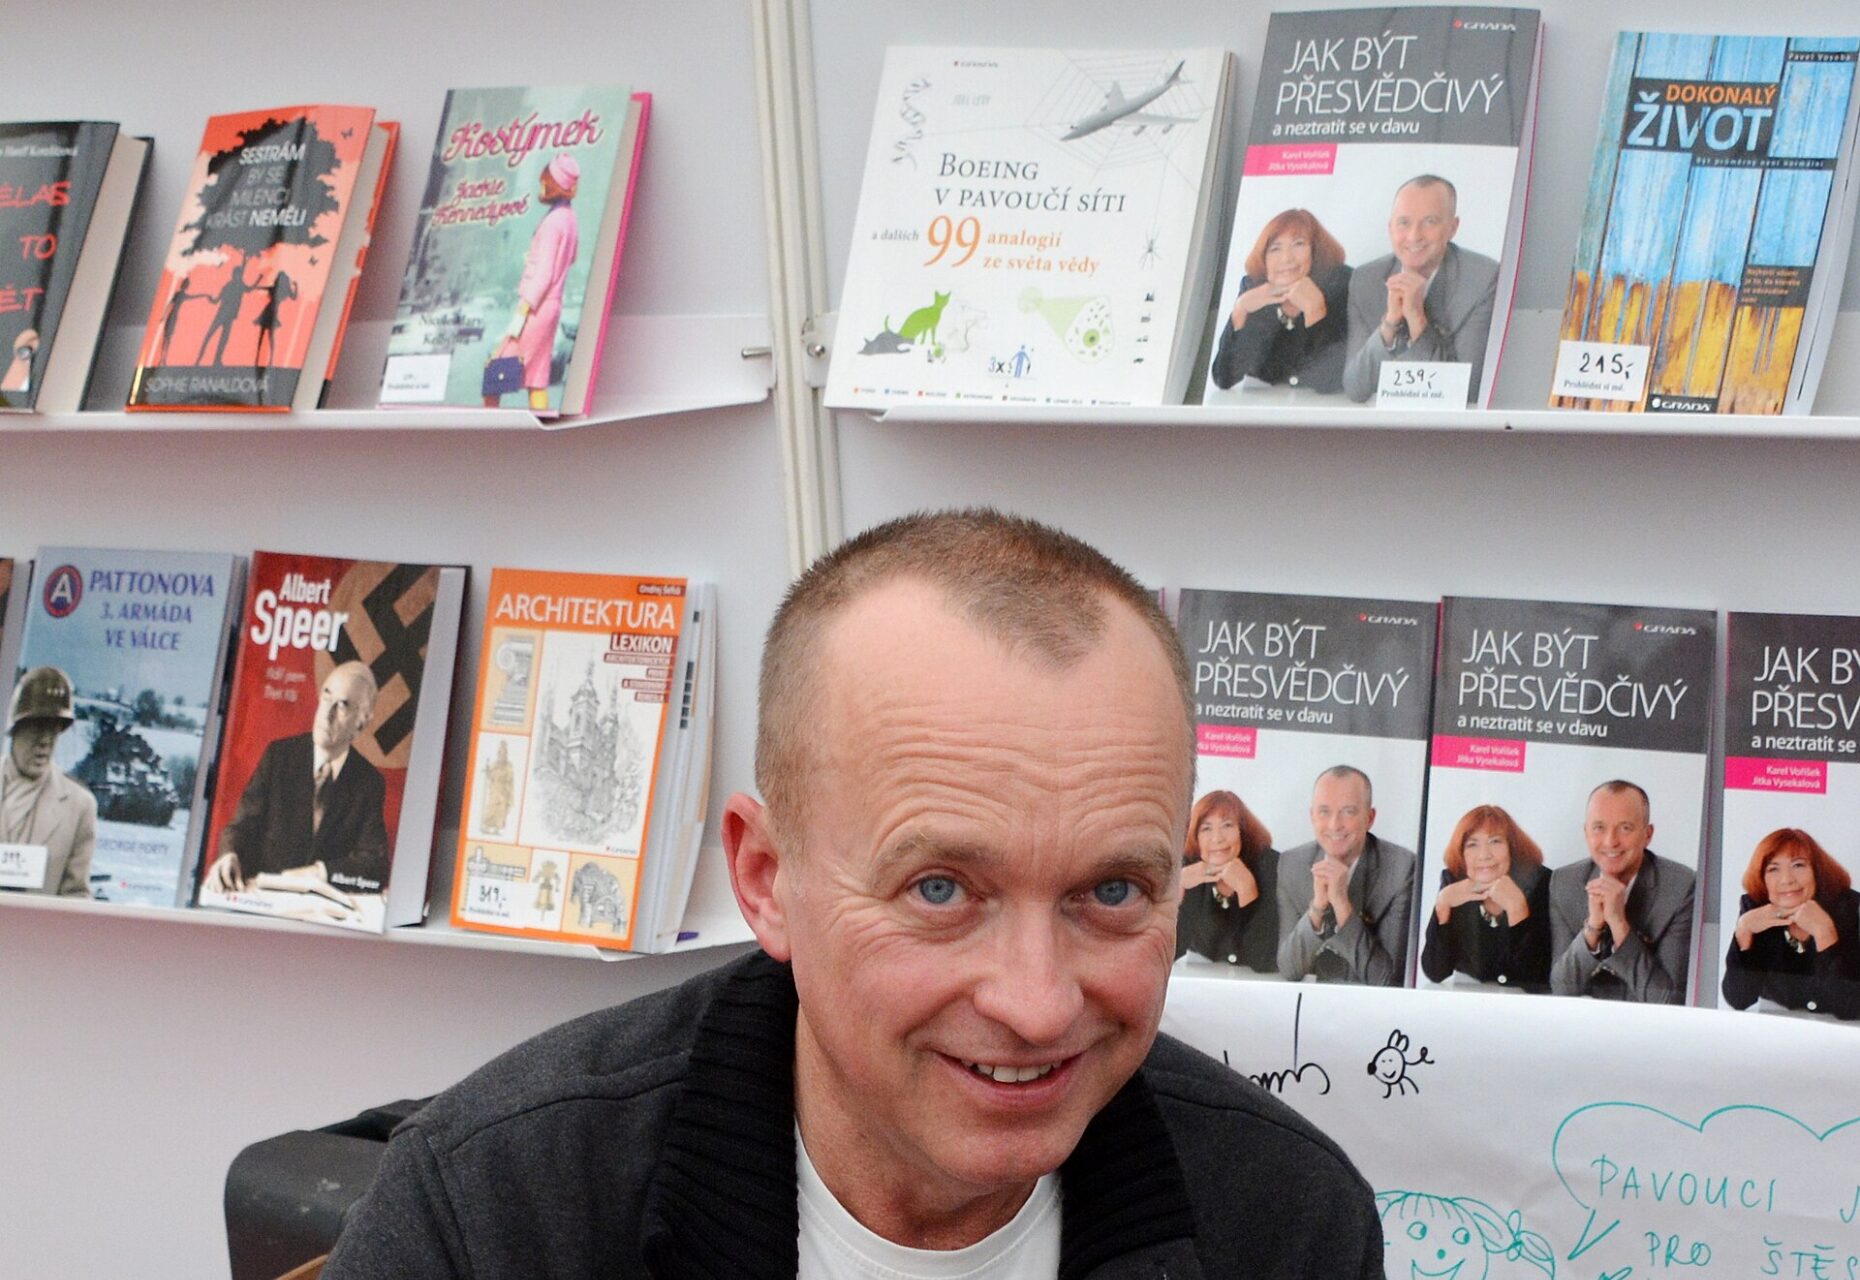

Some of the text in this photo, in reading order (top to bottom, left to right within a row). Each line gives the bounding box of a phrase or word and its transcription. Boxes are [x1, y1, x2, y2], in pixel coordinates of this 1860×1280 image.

[1283, 30, 1418, 74] JAK BÝT
[1276, 72, 1505, 115] PŘESVĚDČIVÝ
[1666, 83, 1776, 105] DOKONALÝ
[1272, 118, 1420, 136] a neztratit se v davu
[1627, 91, 1773, 151] ŽIVOT
[239, 141, 306, 165] SESTRÁM
[443, 109, 604, 168] Kostýmek
[249, 204, 306, 227] NEMĚLI
[20, 233, 58, 261] TO
[923, 215, 981, 268] 99
[983, 257, 1100, 278] ze světa vědy
[1661, 401, 1712, 412] GRADA
[90, 570, 214, 597] PATTONOVA
[278, 573, 331, 605] Albert
[117, 600, 192, 624] ARMÁDA
[251, 589, 349, 661] Speer
[495, 593, 676, 629] ARCHITEKTURA
[105, 626, 181, 650] VE VÁLCE
[612, 633, 674, 654] LEXIKON
[1198, 618, 1326, 660] JAK BÝT
[1462, 627, 1599, 670] JAK BÝT
[1753, 646, 1820, 684] JAK
[1195, 655, 1410, 708] PŘESVĚDČIVÝ
[1458, 666, 1689, 721] PŘESVĚDČIVÝ
[1205, 703, 1264, 719] neztratit
[1267, 706, 1282, 721] se
[1286, 708, 1296, 721] v
[1297, 704, 1334, 725] davu
[1457, 715, 1609, 738] a neztratit se v davu
[1751, 736, 1857, 753] a neztratit se
[1590, 1154, 1776, 1213] PAVOUCI
[1644, 1231, 1712, 1268] PRO
